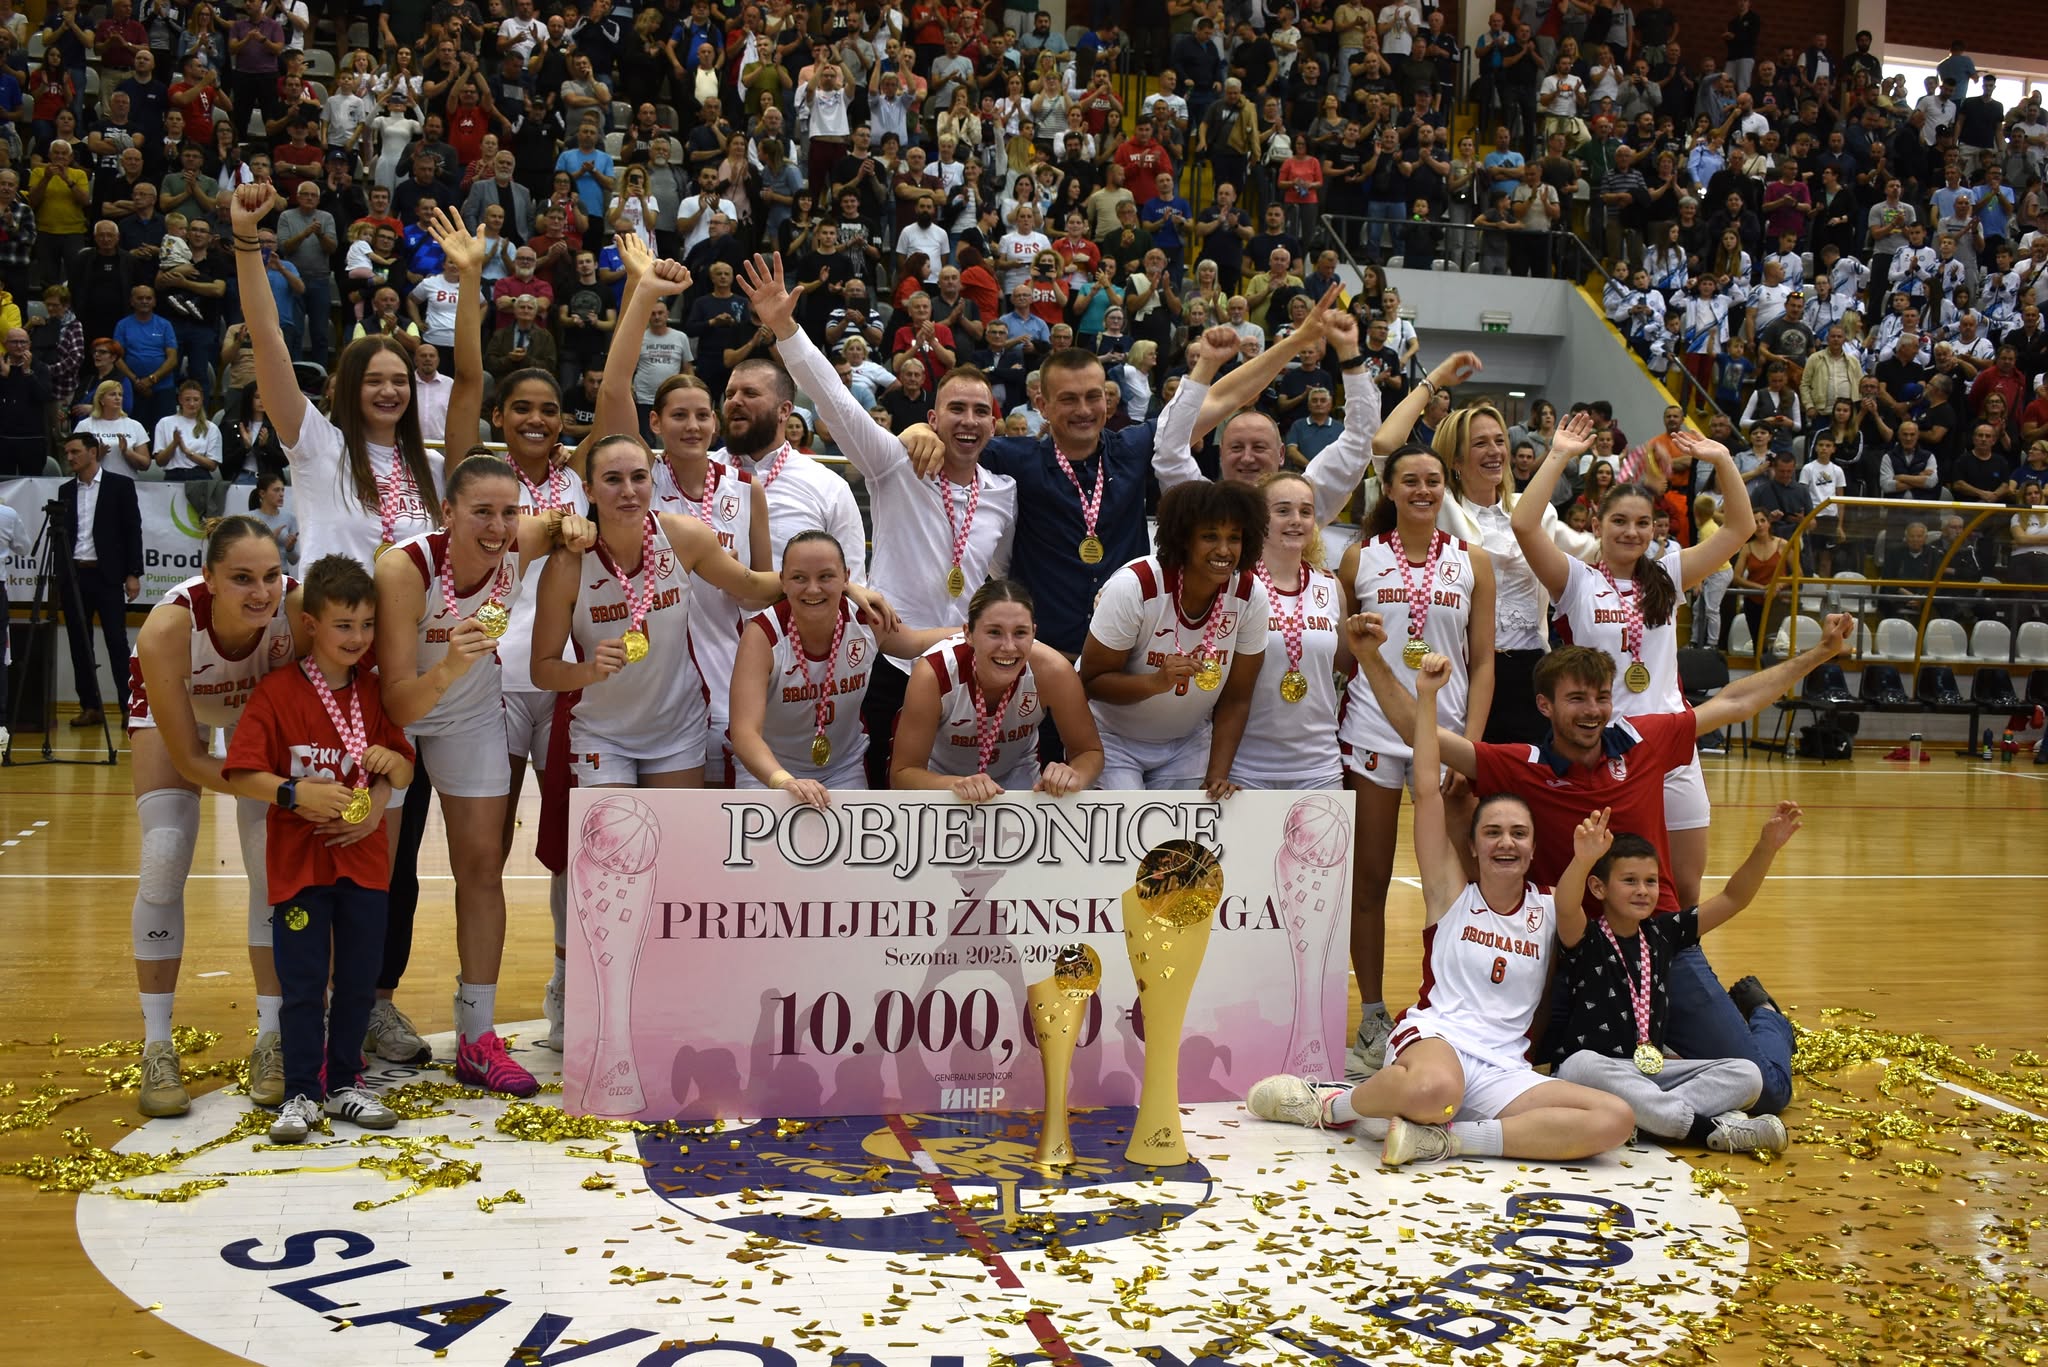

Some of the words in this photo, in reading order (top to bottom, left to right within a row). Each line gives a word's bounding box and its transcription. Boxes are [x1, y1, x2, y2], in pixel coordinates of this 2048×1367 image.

[1014, 242, 1040, 254] BnS
[437, 290, 457, 304] Bn
[5, 555, 37, 570] Plin
[146, 548, 202, 568] Brod
[590, 602, 629, 623] BROD
[652, 587, 681, 611] SAVI
[1434, 590, 1461, 609] SAVI
[1307, 615, 1333, 632] SAVI
[425, 626, 455, 643] BR
[193, 680, 235, 695] BROD
[783, 683, 818, 703] BROD
[840, 672, 866, 695] SAVI
[951, 734, 980, 748] BRO
[1008, 722, 1034, 742] SAVI
[311, 742, 341, 764] ŽKK
[1364, 750, 1378, 771] 3
[721, 802, 1223, 879] POBJEDNICE
[655, 898, 937, 940] PREMIJER
[950, 888, 1124, 937] ŽENSK
[1211, 895, 1287, 932] GA
[1461, 925, 1494, 948] BROD
[1495, 934, 1513, 952] NA
[1514, 940, 1540, 960] SAVI
[885, 946, 959, 966] Sezona
[1490, 956, 1508, 984] 6
[934, 1073, 975, 1082] GENERALNI
[977, 1072, 1013, 1081] SPONZOR
[961, 1087, 1005, 1109] HEP
